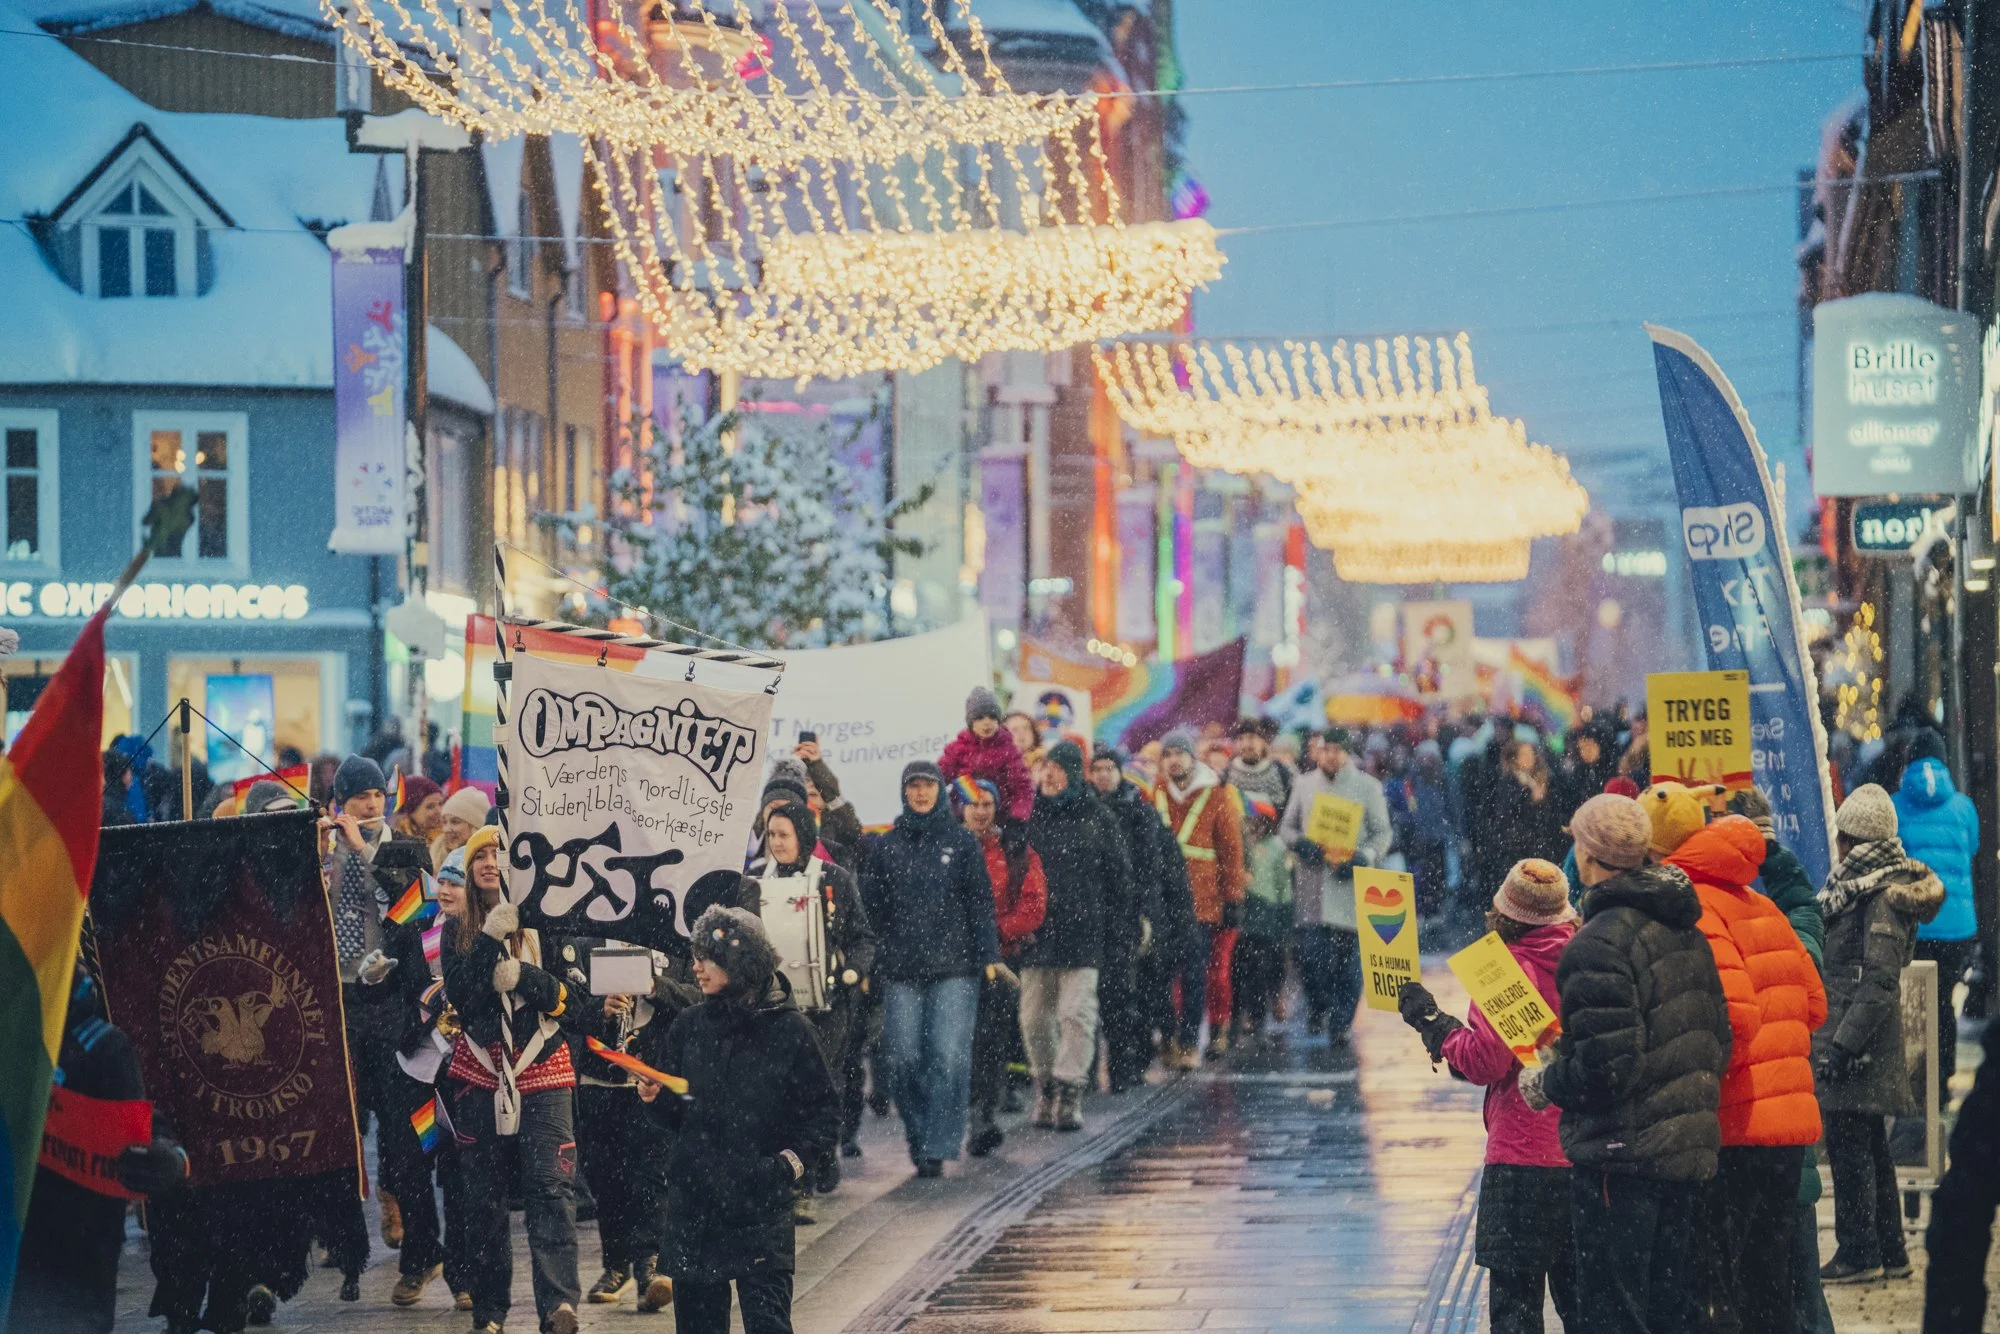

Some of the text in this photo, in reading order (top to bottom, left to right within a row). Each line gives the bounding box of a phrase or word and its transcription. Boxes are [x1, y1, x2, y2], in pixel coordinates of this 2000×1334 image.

[1853, 343, 1935, 370] Brille
[1853, 376, 1936, 400] huset
[1664, 697, 1731, 723] TRYGG
[1666, 730, 1697, 748] HOS
[1701, 728, 1734, 747] MEG
[542, 756, 628, 788] Værdens
[639, 775, 734, 821] nordligste
[1370, 954, 1378, 968] IS
[1385, 956, 1412, 973] HUMAN
[159, 933, 329, 1058] STUDENTSAMFUNNET
[1483, 980, 1529, 1018] RENKLERDE
[1498, 1001, 1545, 1041] GÜÇ VAR
[210, 1072, 314, 1121] TROMSØ
[216, 1129, 318, 1167] 1967
